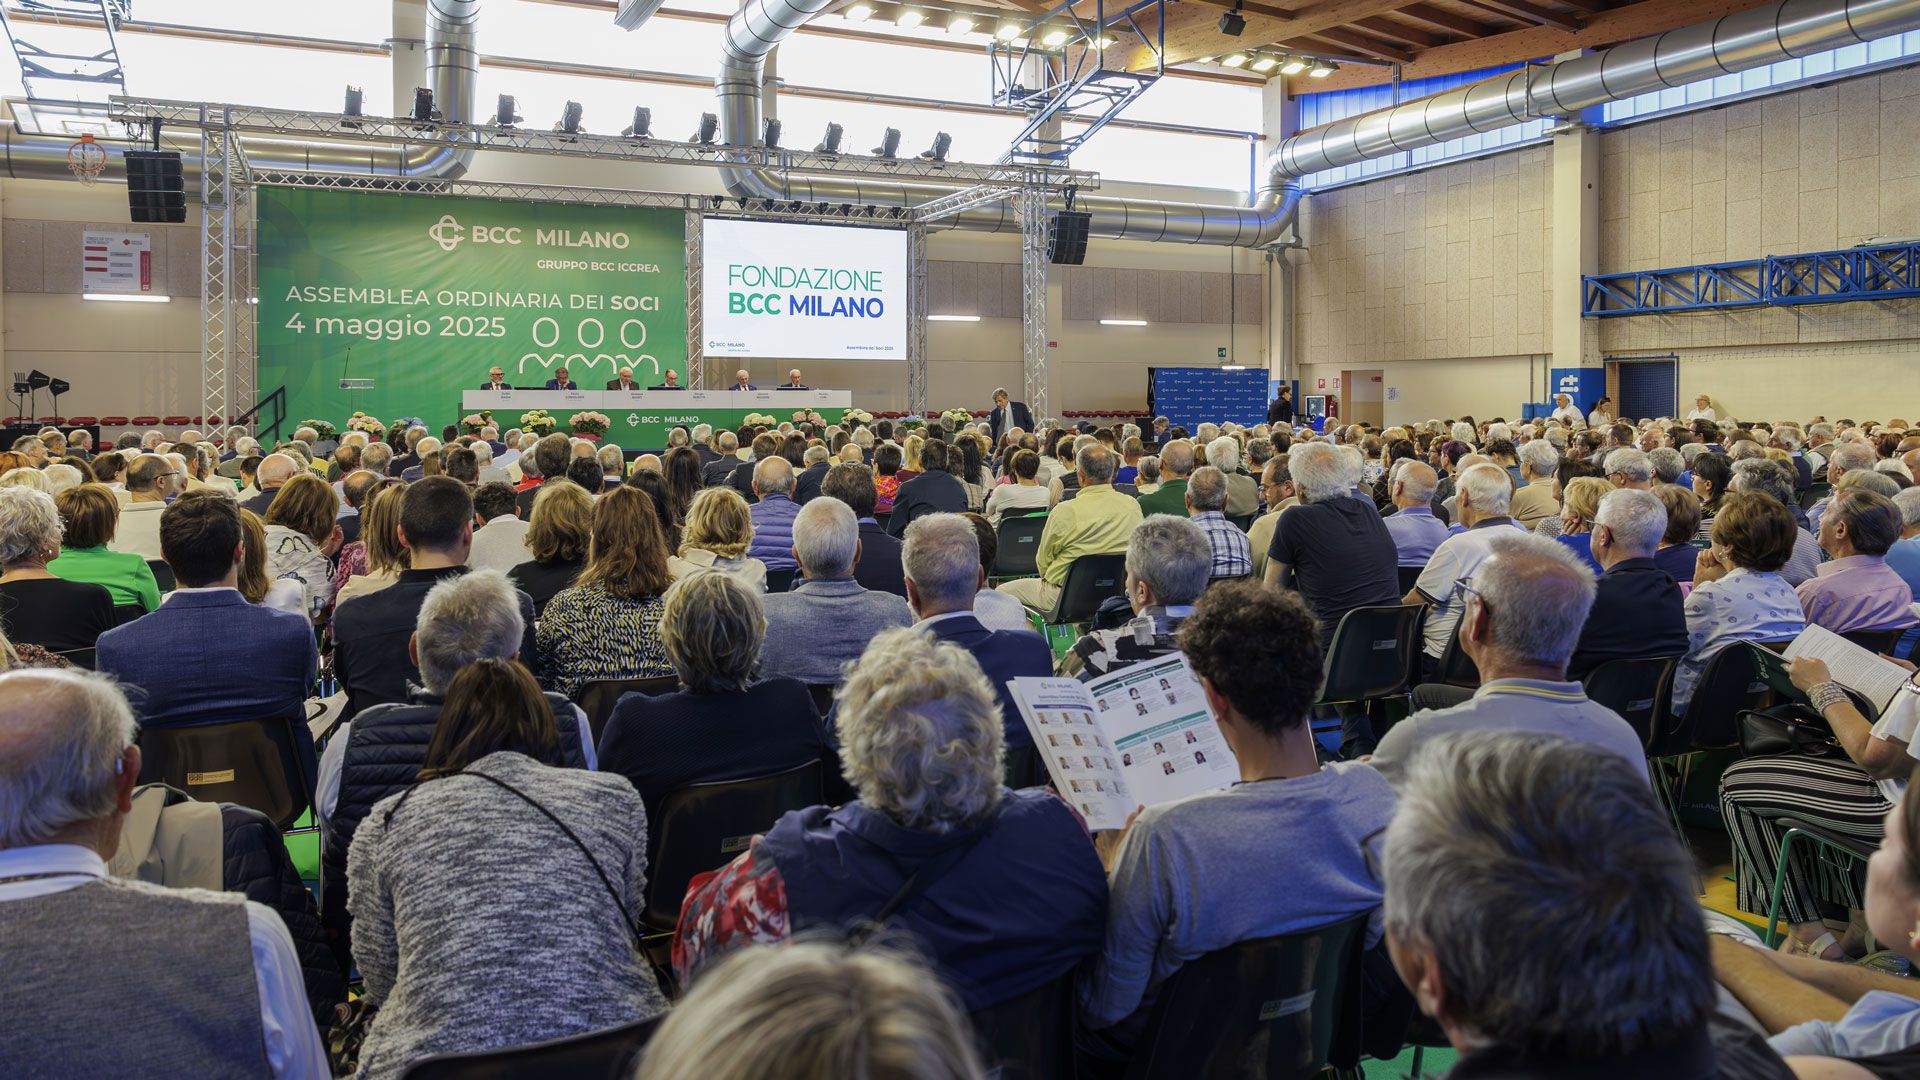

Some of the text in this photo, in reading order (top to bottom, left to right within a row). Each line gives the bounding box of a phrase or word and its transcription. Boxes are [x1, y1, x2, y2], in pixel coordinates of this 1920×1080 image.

[472, 225, 630, 249] BCC MILANO
[537, 259, 660, 273] GRUPPO BCC ICCREA
[728, 264, 883, 292] FONDAZIONE
[285, 286, 659, 312] ASSEMBLEA ORDINARIA DEI SOCI
[728, 292, 884, 318] BCC MILANO
[285, 313, 506, 341] 4 maggio 2025
